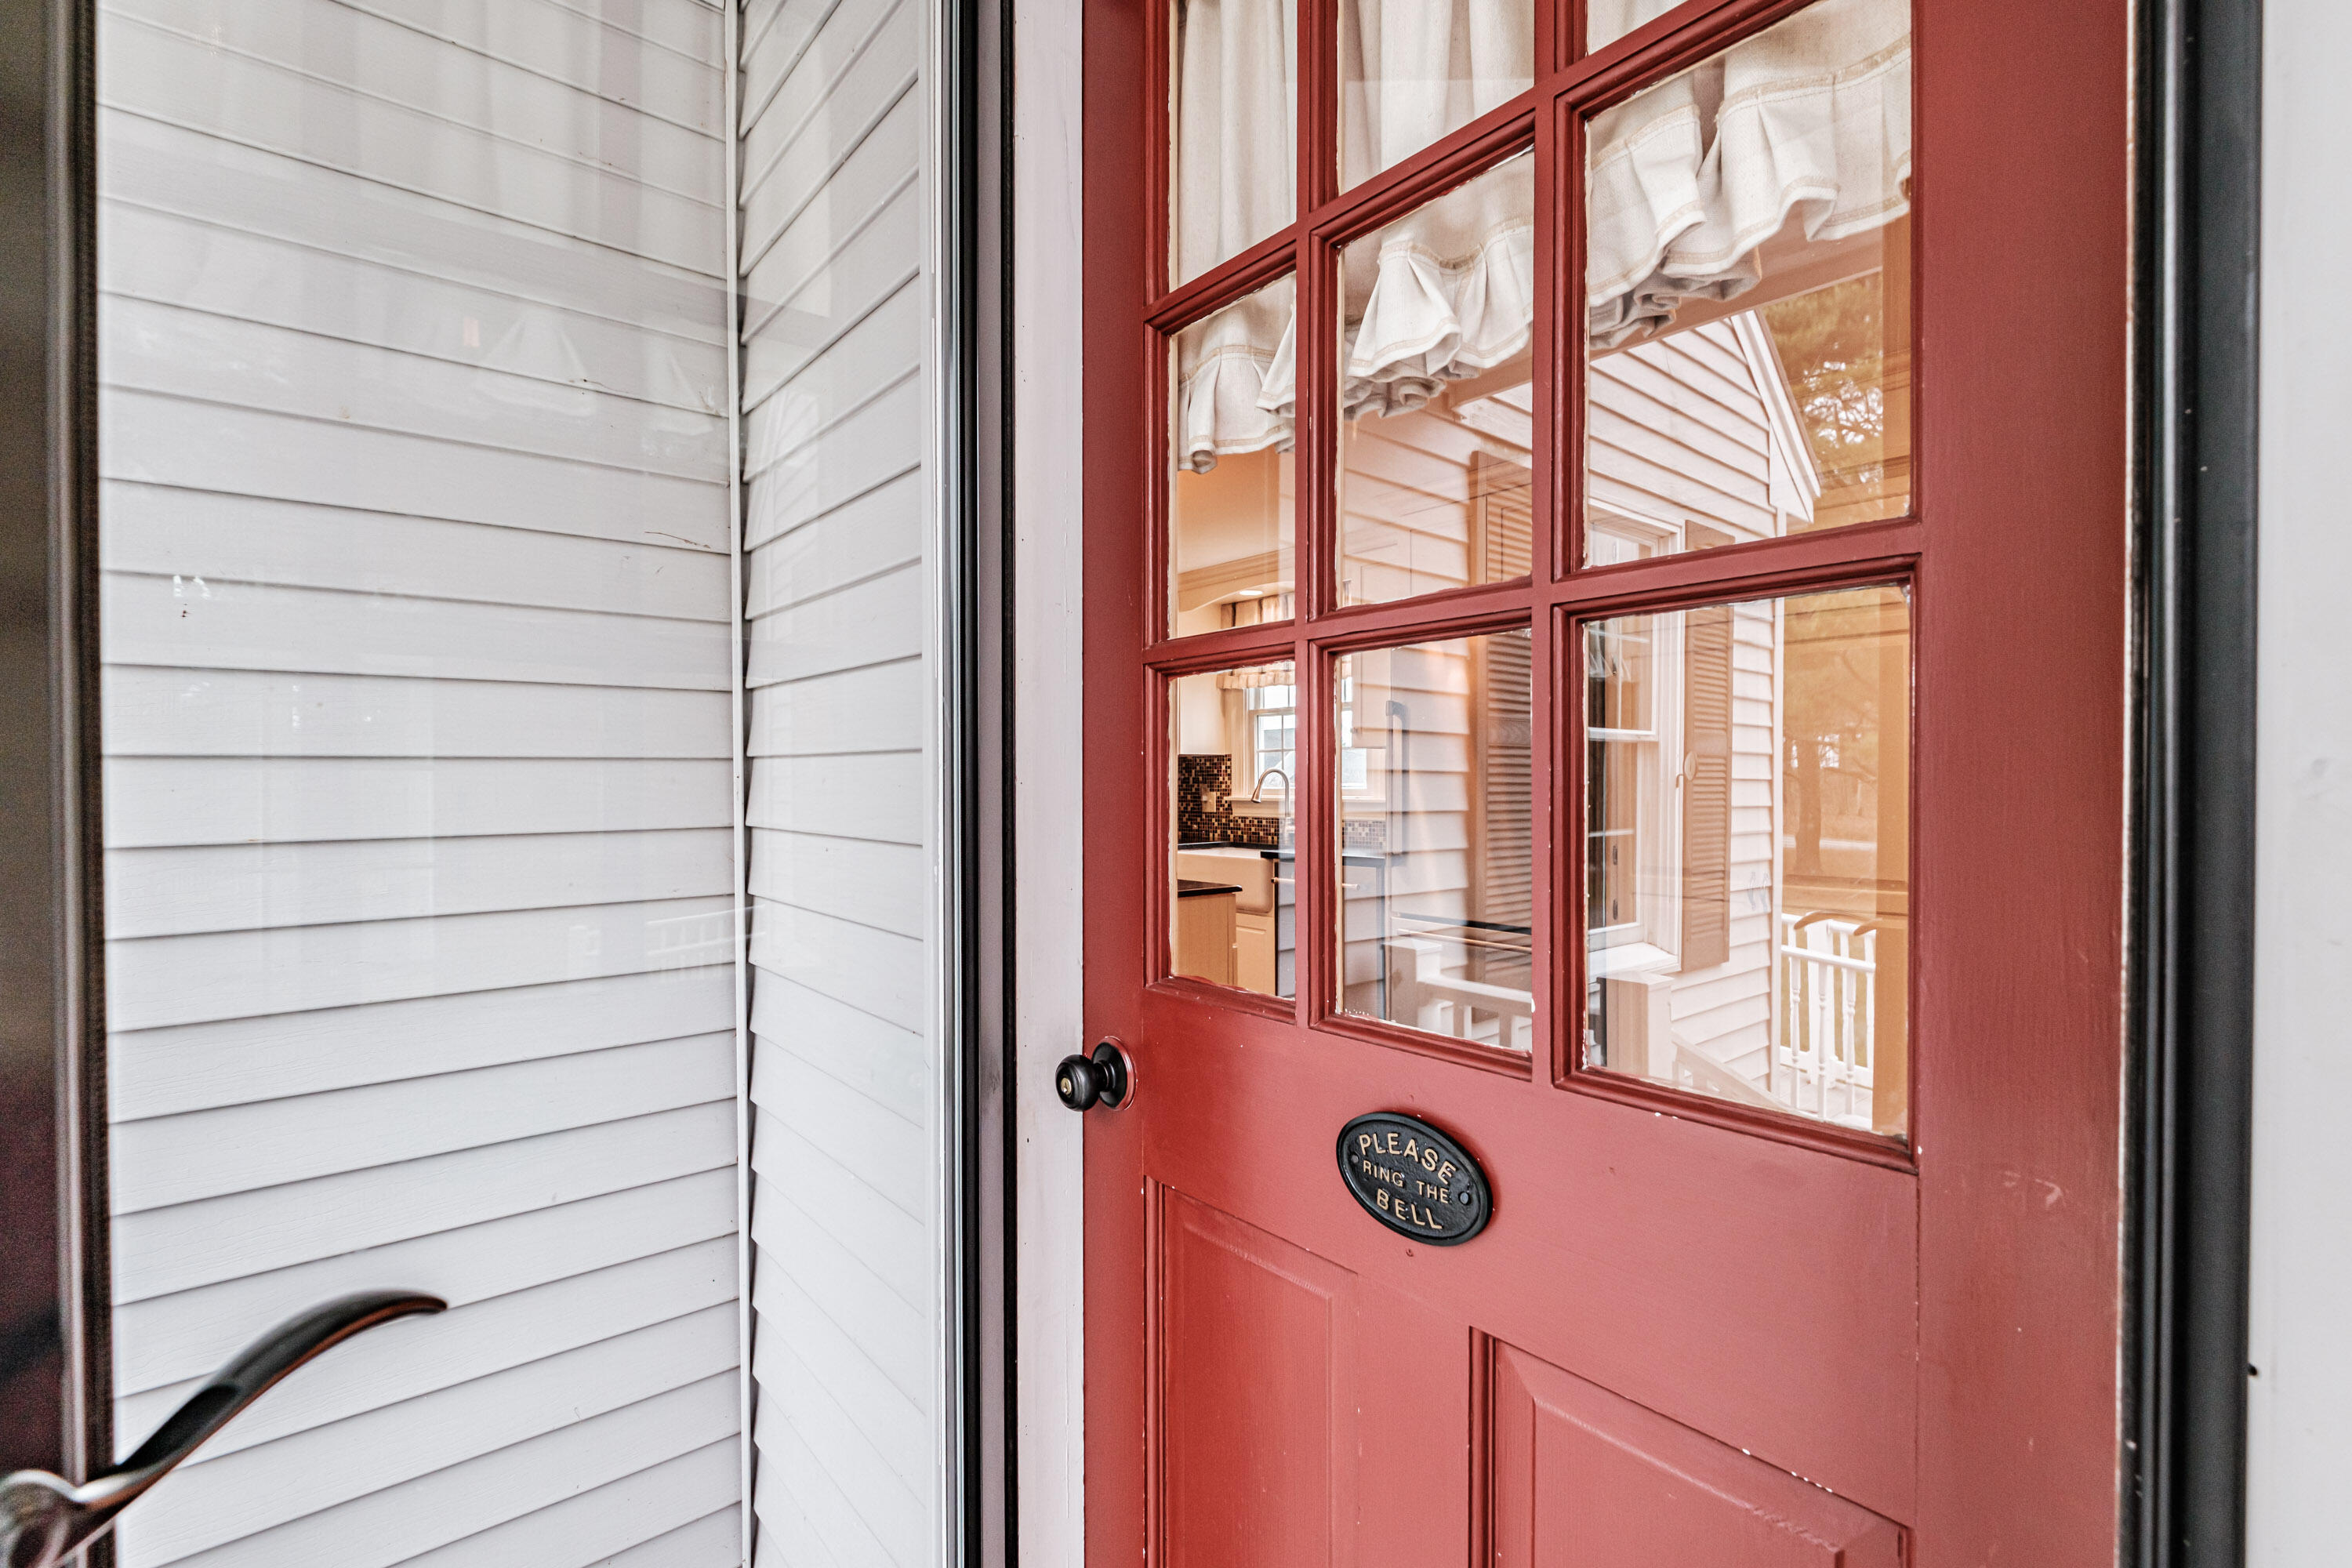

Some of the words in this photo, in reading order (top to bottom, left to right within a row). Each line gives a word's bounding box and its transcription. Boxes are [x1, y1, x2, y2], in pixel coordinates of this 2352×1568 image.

[1359, 1132, 1457, 1185] PLEASE
[1363, 1160, 1403, 1187] RING
[1416, 1180, 1449, 1204] THE
[1376, 1188, 1443, 1229] BELL
